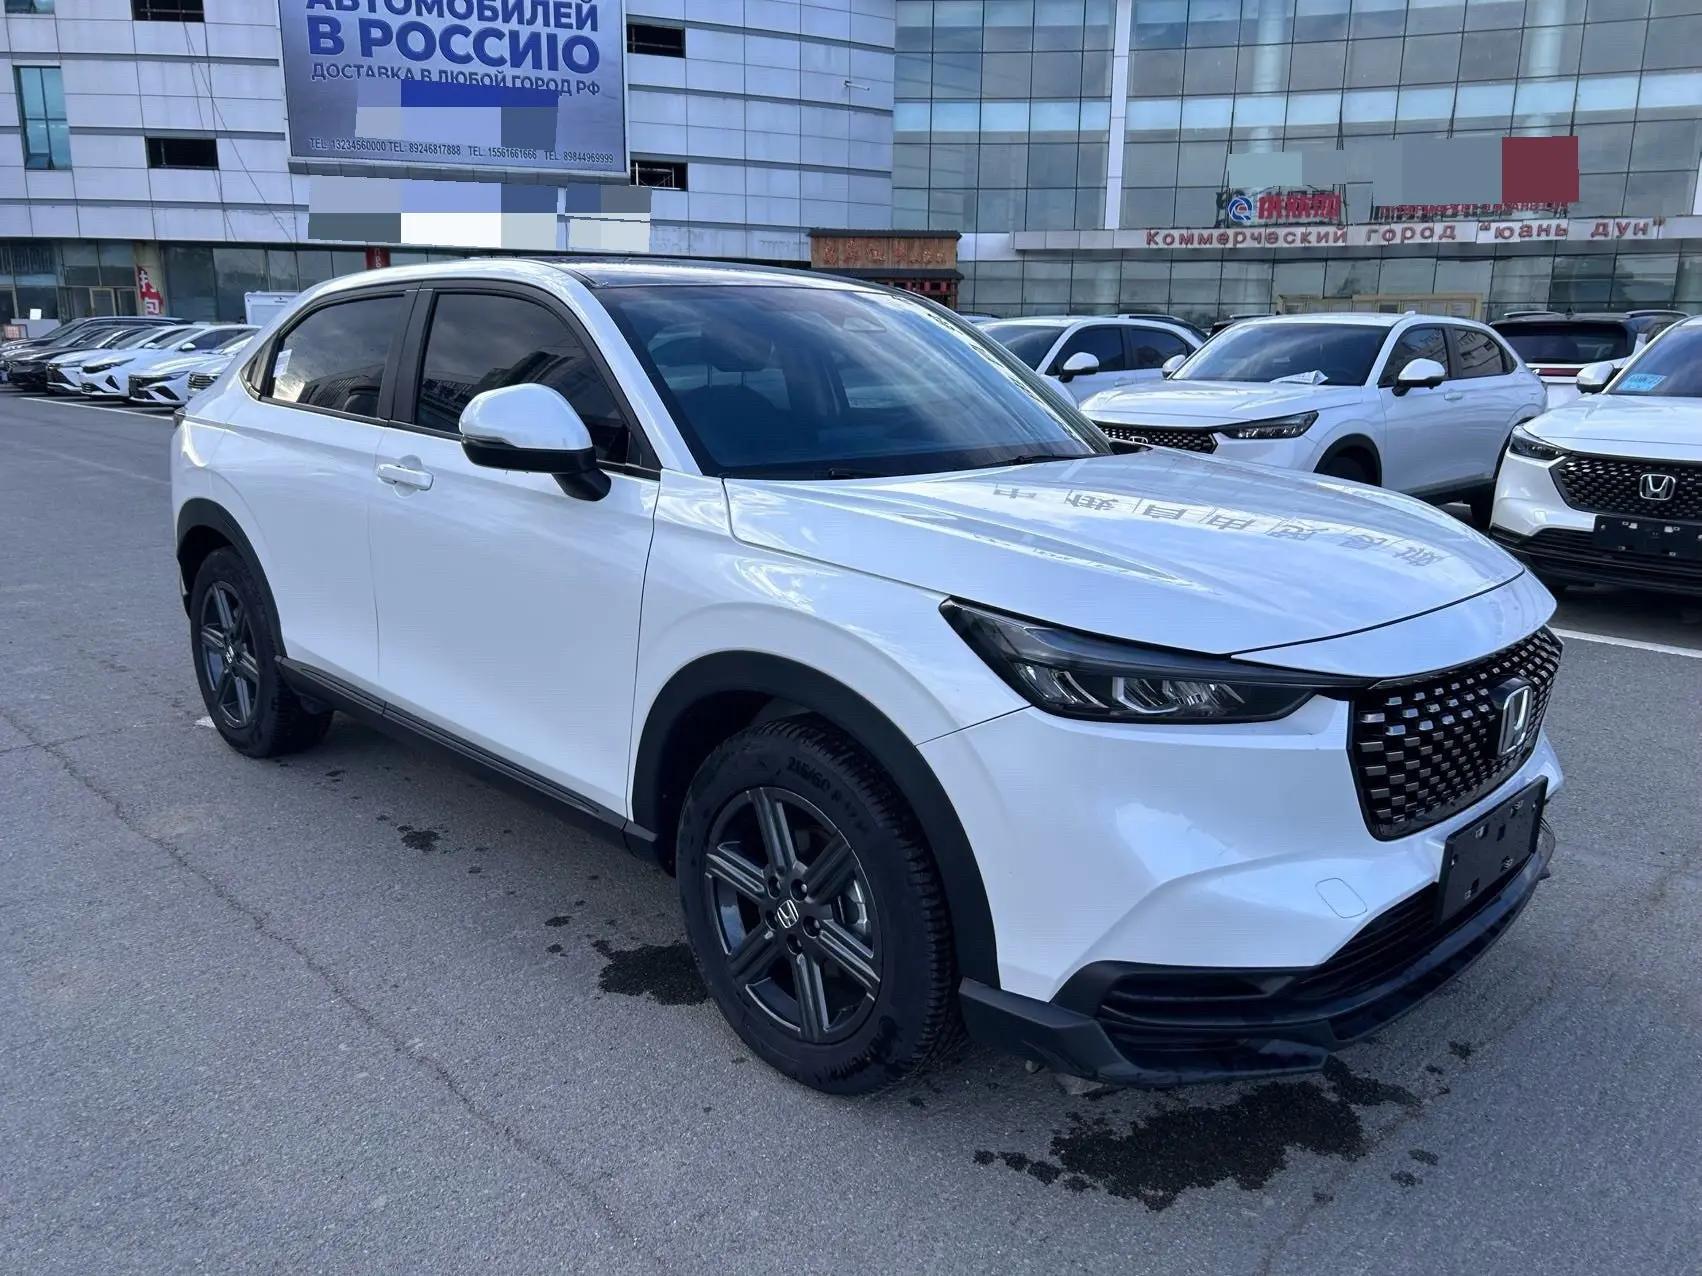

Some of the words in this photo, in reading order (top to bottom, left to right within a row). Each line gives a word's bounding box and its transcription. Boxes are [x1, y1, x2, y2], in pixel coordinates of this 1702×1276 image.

[307, 15, 345, 55] В
[358, 17, 600, 74] РОССИЮ
[312, 62, 416, 81] ДОСТАВКА
[420, 68, 433, 81] В
[511, 75, 573, 97] ГОРОД
[576, 80, 601, 95] РФ
[1146, 226, 1347, 247] Коммерческий
[1366, 224, 1457, 244] город
